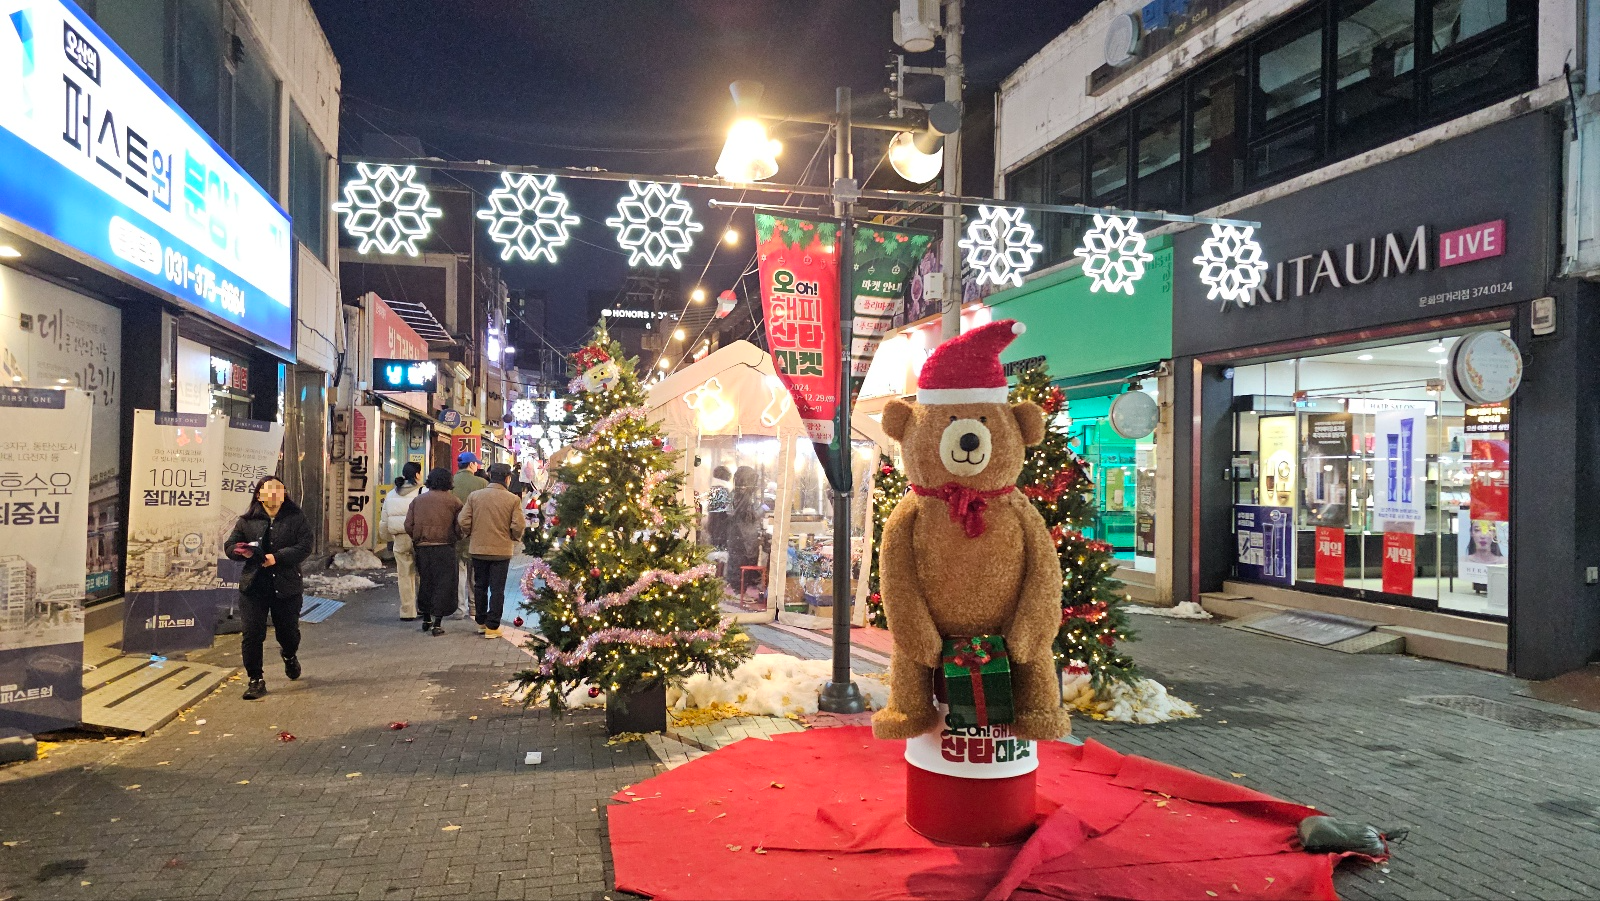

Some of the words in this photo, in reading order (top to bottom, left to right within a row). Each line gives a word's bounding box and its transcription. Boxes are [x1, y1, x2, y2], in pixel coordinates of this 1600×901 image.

[65, 30, 97, 79] 오산역
[62, 73, 172, 213] 퍼스트원
[1220, 225, 1426, 313] RITAUM
[1445, 227, 1495, 260] LIVE
[773, 269, 795, 294] 오
[795, 280, 818, 295] Oh!
[861, 279, 881, 292] 마켓
[882, 280, 903, 293] 안내
[1419, 289, 1470, 307] 문화의거리점
[1472, 281, 1513, 298] 374.0124
[612, 309, 650, 319] HONORS
[771, 295, 822, 323] 해피
[771, 321, 824, 350] 산타
[773, 349, 824, 377] 마켓
[790, 383, 812, 392] 2024.
[2, 394, 29, 402] FIRST
[32, 395, 52, 403] ONE
[33, 441, 77, 452] 동탄신도시
[51, 453, 60, 463] 등
[149, 467, 207, 489] 100년
[143, 489, 210, 507] 절대상권
[1317, 541, 1342, 558] 세일
[1386, 547, 1412, 565] 세일
[158, 617, 195, 629] 퍼스트원
[1, 684, 53, 703] 퍼스트원
